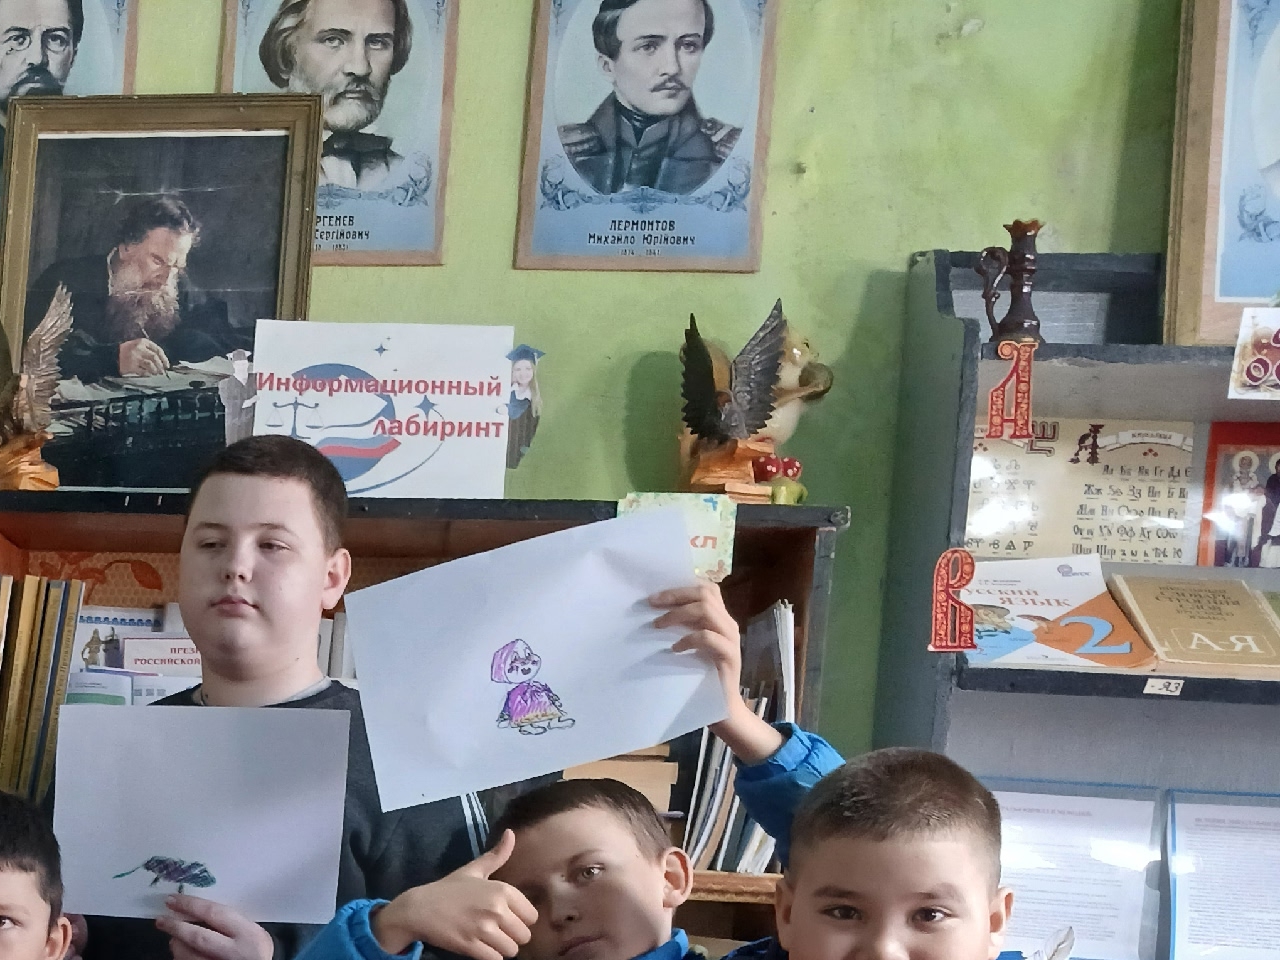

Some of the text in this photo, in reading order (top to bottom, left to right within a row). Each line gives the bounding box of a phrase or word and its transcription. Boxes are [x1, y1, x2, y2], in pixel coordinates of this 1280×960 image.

[316, 215, 354, 227] РГЕНЕВ
[609, 220, 676, 231] ЛЕРМОНТОВ
[588, 233, 635, 246] Михайло
[257, 372, 502, 396] Информационный
[373, 413, 504, 438] лабиринт
[1060, 615, 1133, 655] 2
[1189, 632, 1264, 654] А-Я
